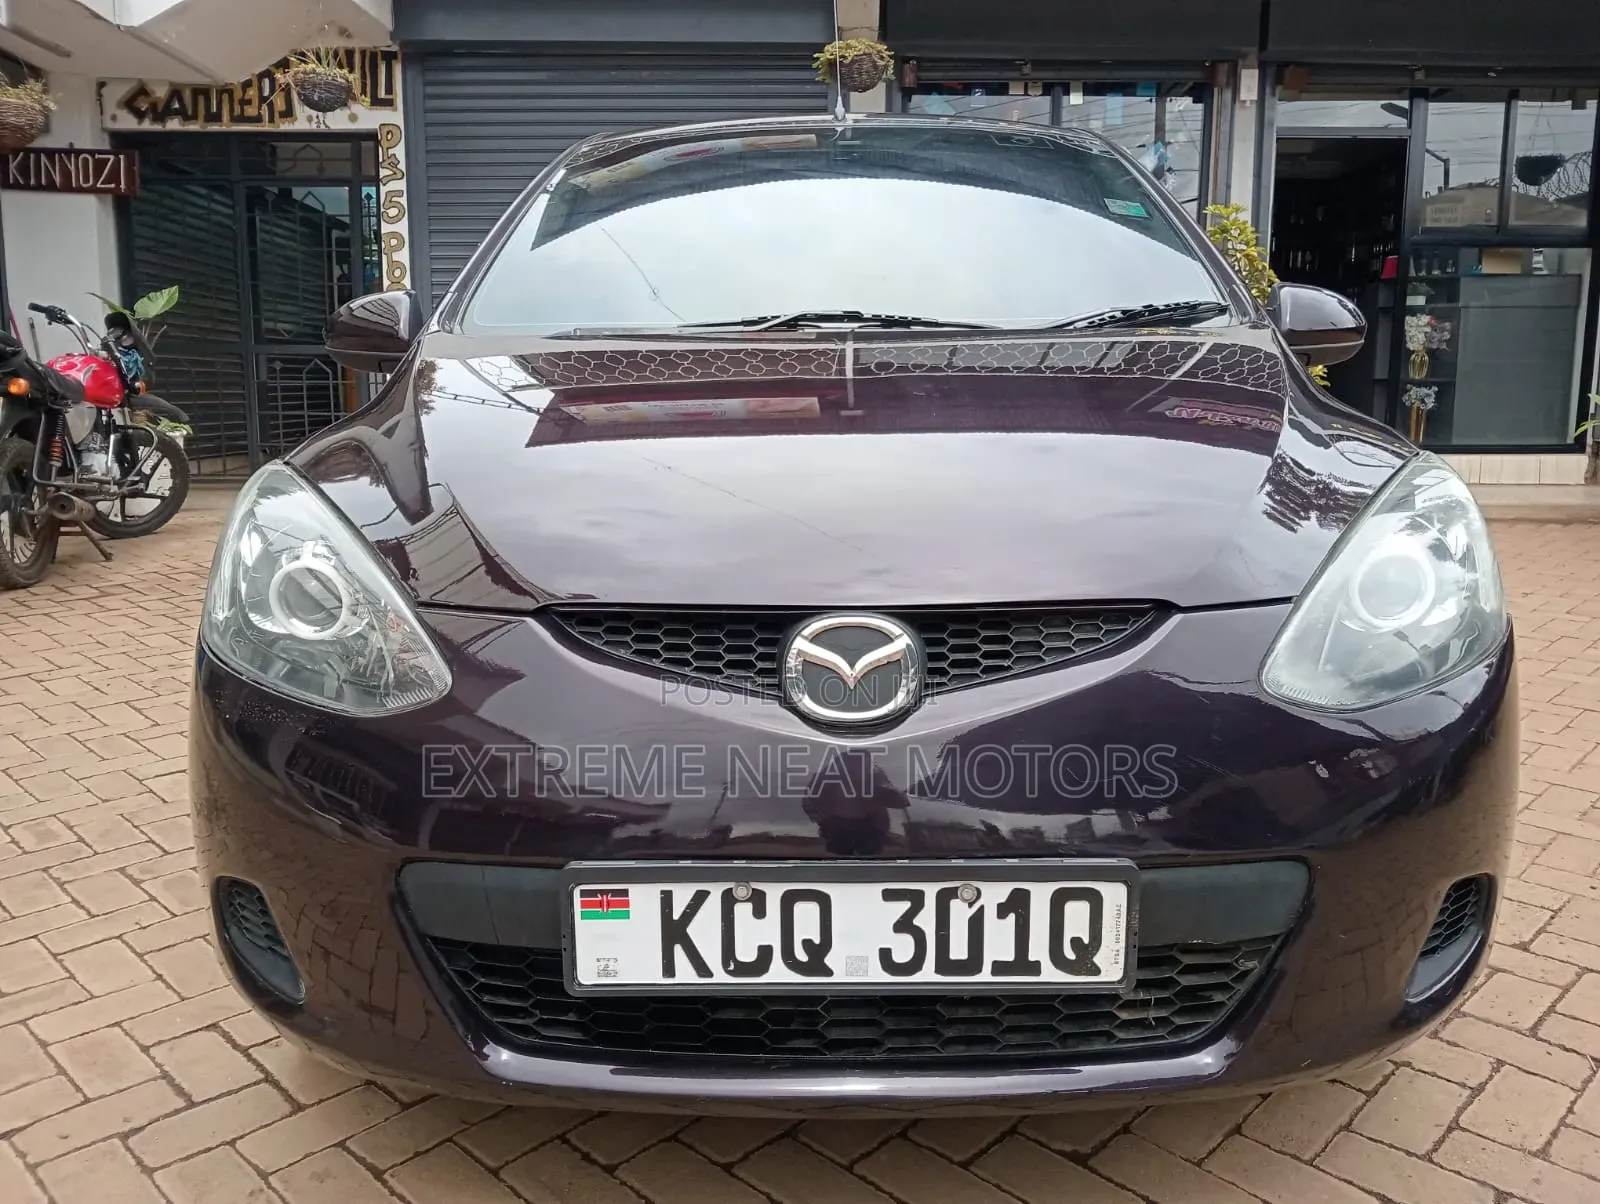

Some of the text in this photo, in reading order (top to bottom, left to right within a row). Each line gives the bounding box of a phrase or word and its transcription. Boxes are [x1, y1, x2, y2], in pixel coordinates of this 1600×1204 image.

[8, 151, 126, 193] KINYOZI
[659, 886, 835, 979] KCQ
[877, 885, 1104, 978] 301Q
